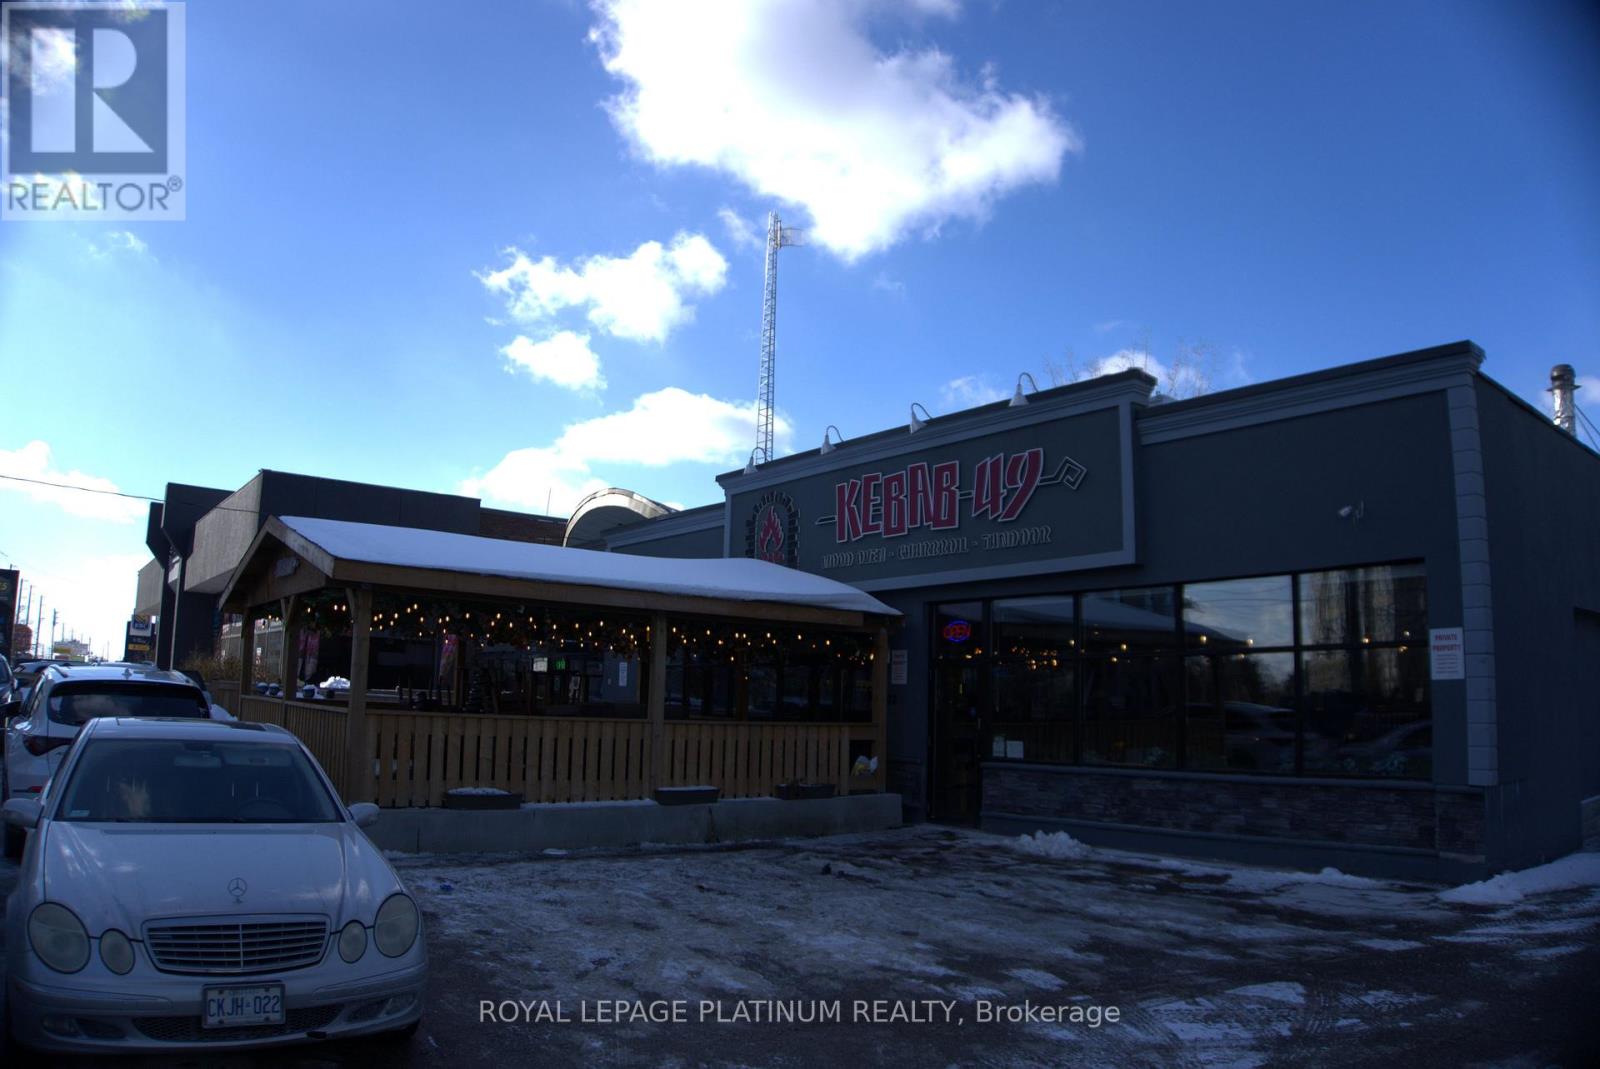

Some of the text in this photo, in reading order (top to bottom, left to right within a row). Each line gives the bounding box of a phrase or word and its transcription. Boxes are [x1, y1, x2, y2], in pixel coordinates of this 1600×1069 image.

[836, 448, 1043, 543] KEBAB 49
[208, 995, 281, 1017] CKJH 022
